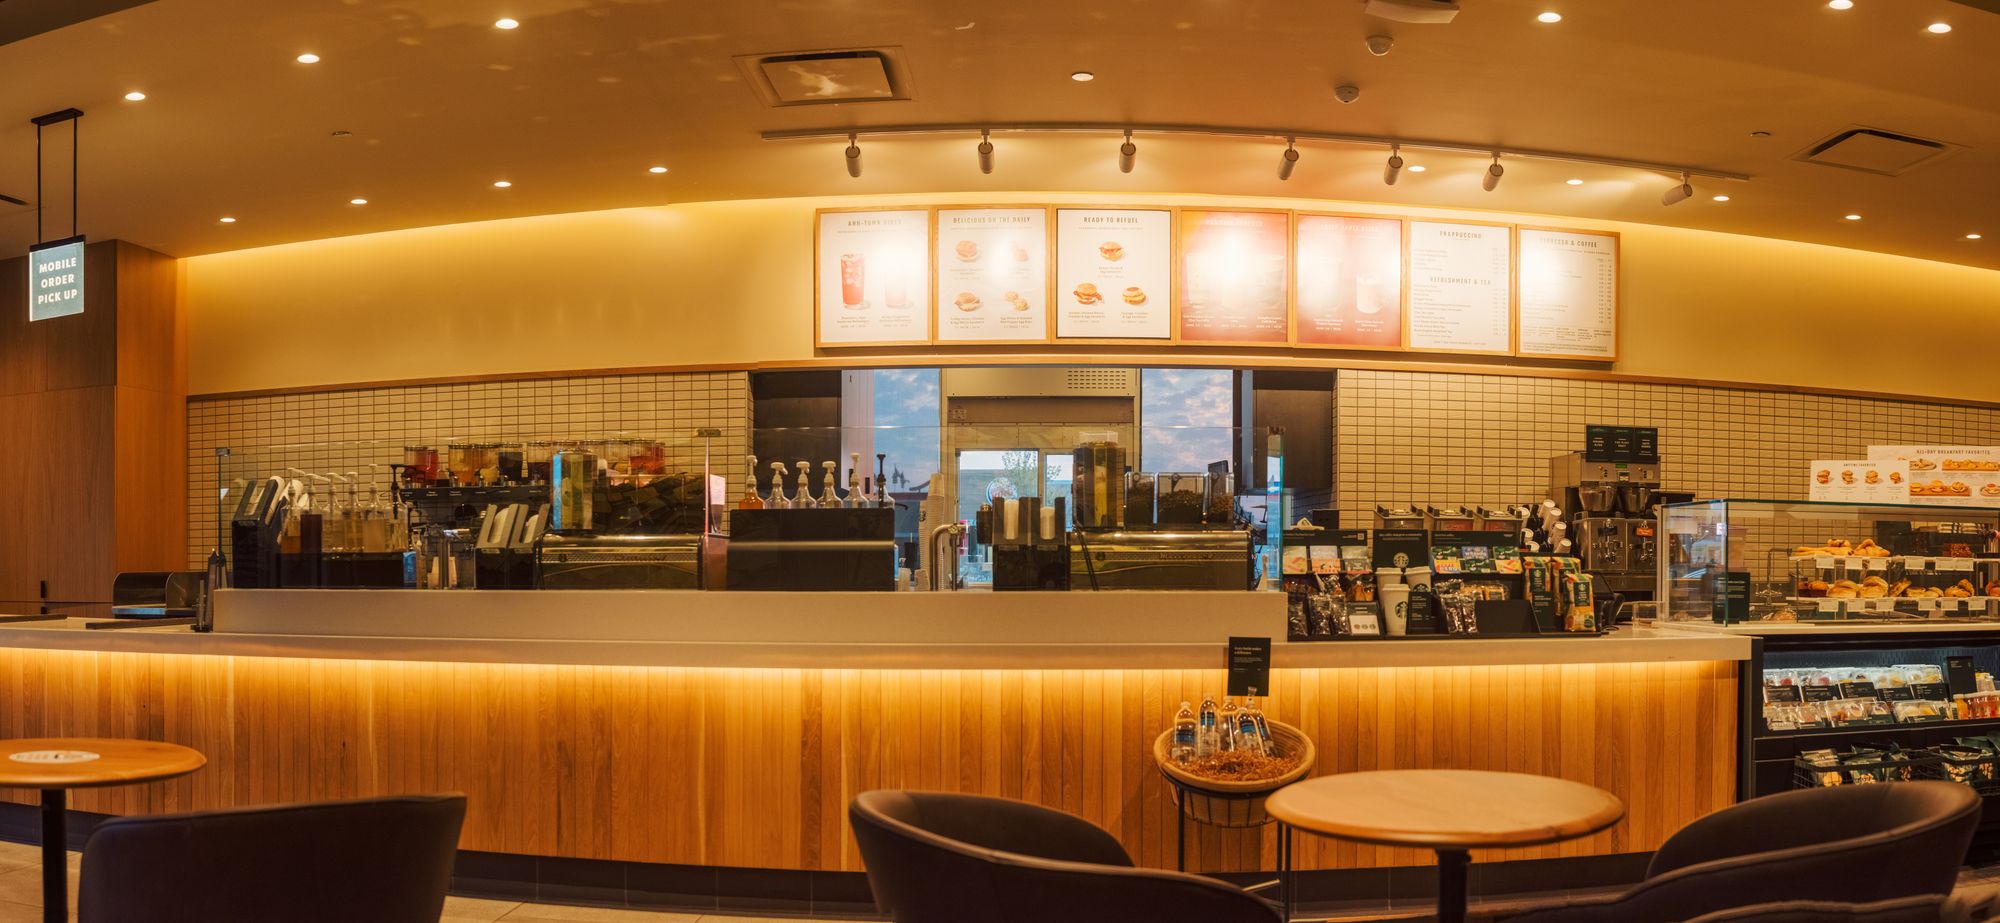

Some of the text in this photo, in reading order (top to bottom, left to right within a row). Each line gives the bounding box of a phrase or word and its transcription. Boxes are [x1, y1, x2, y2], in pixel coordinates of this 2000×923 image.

[952, 216, 986, 224] DELICIOUS
[1576, 240, 1598, 248] COFFEE
[39, 257, 77, 273] MOBILE
[40, 274, 75, 289] ORDER
[38, 289, 78, 305] PICK UP
